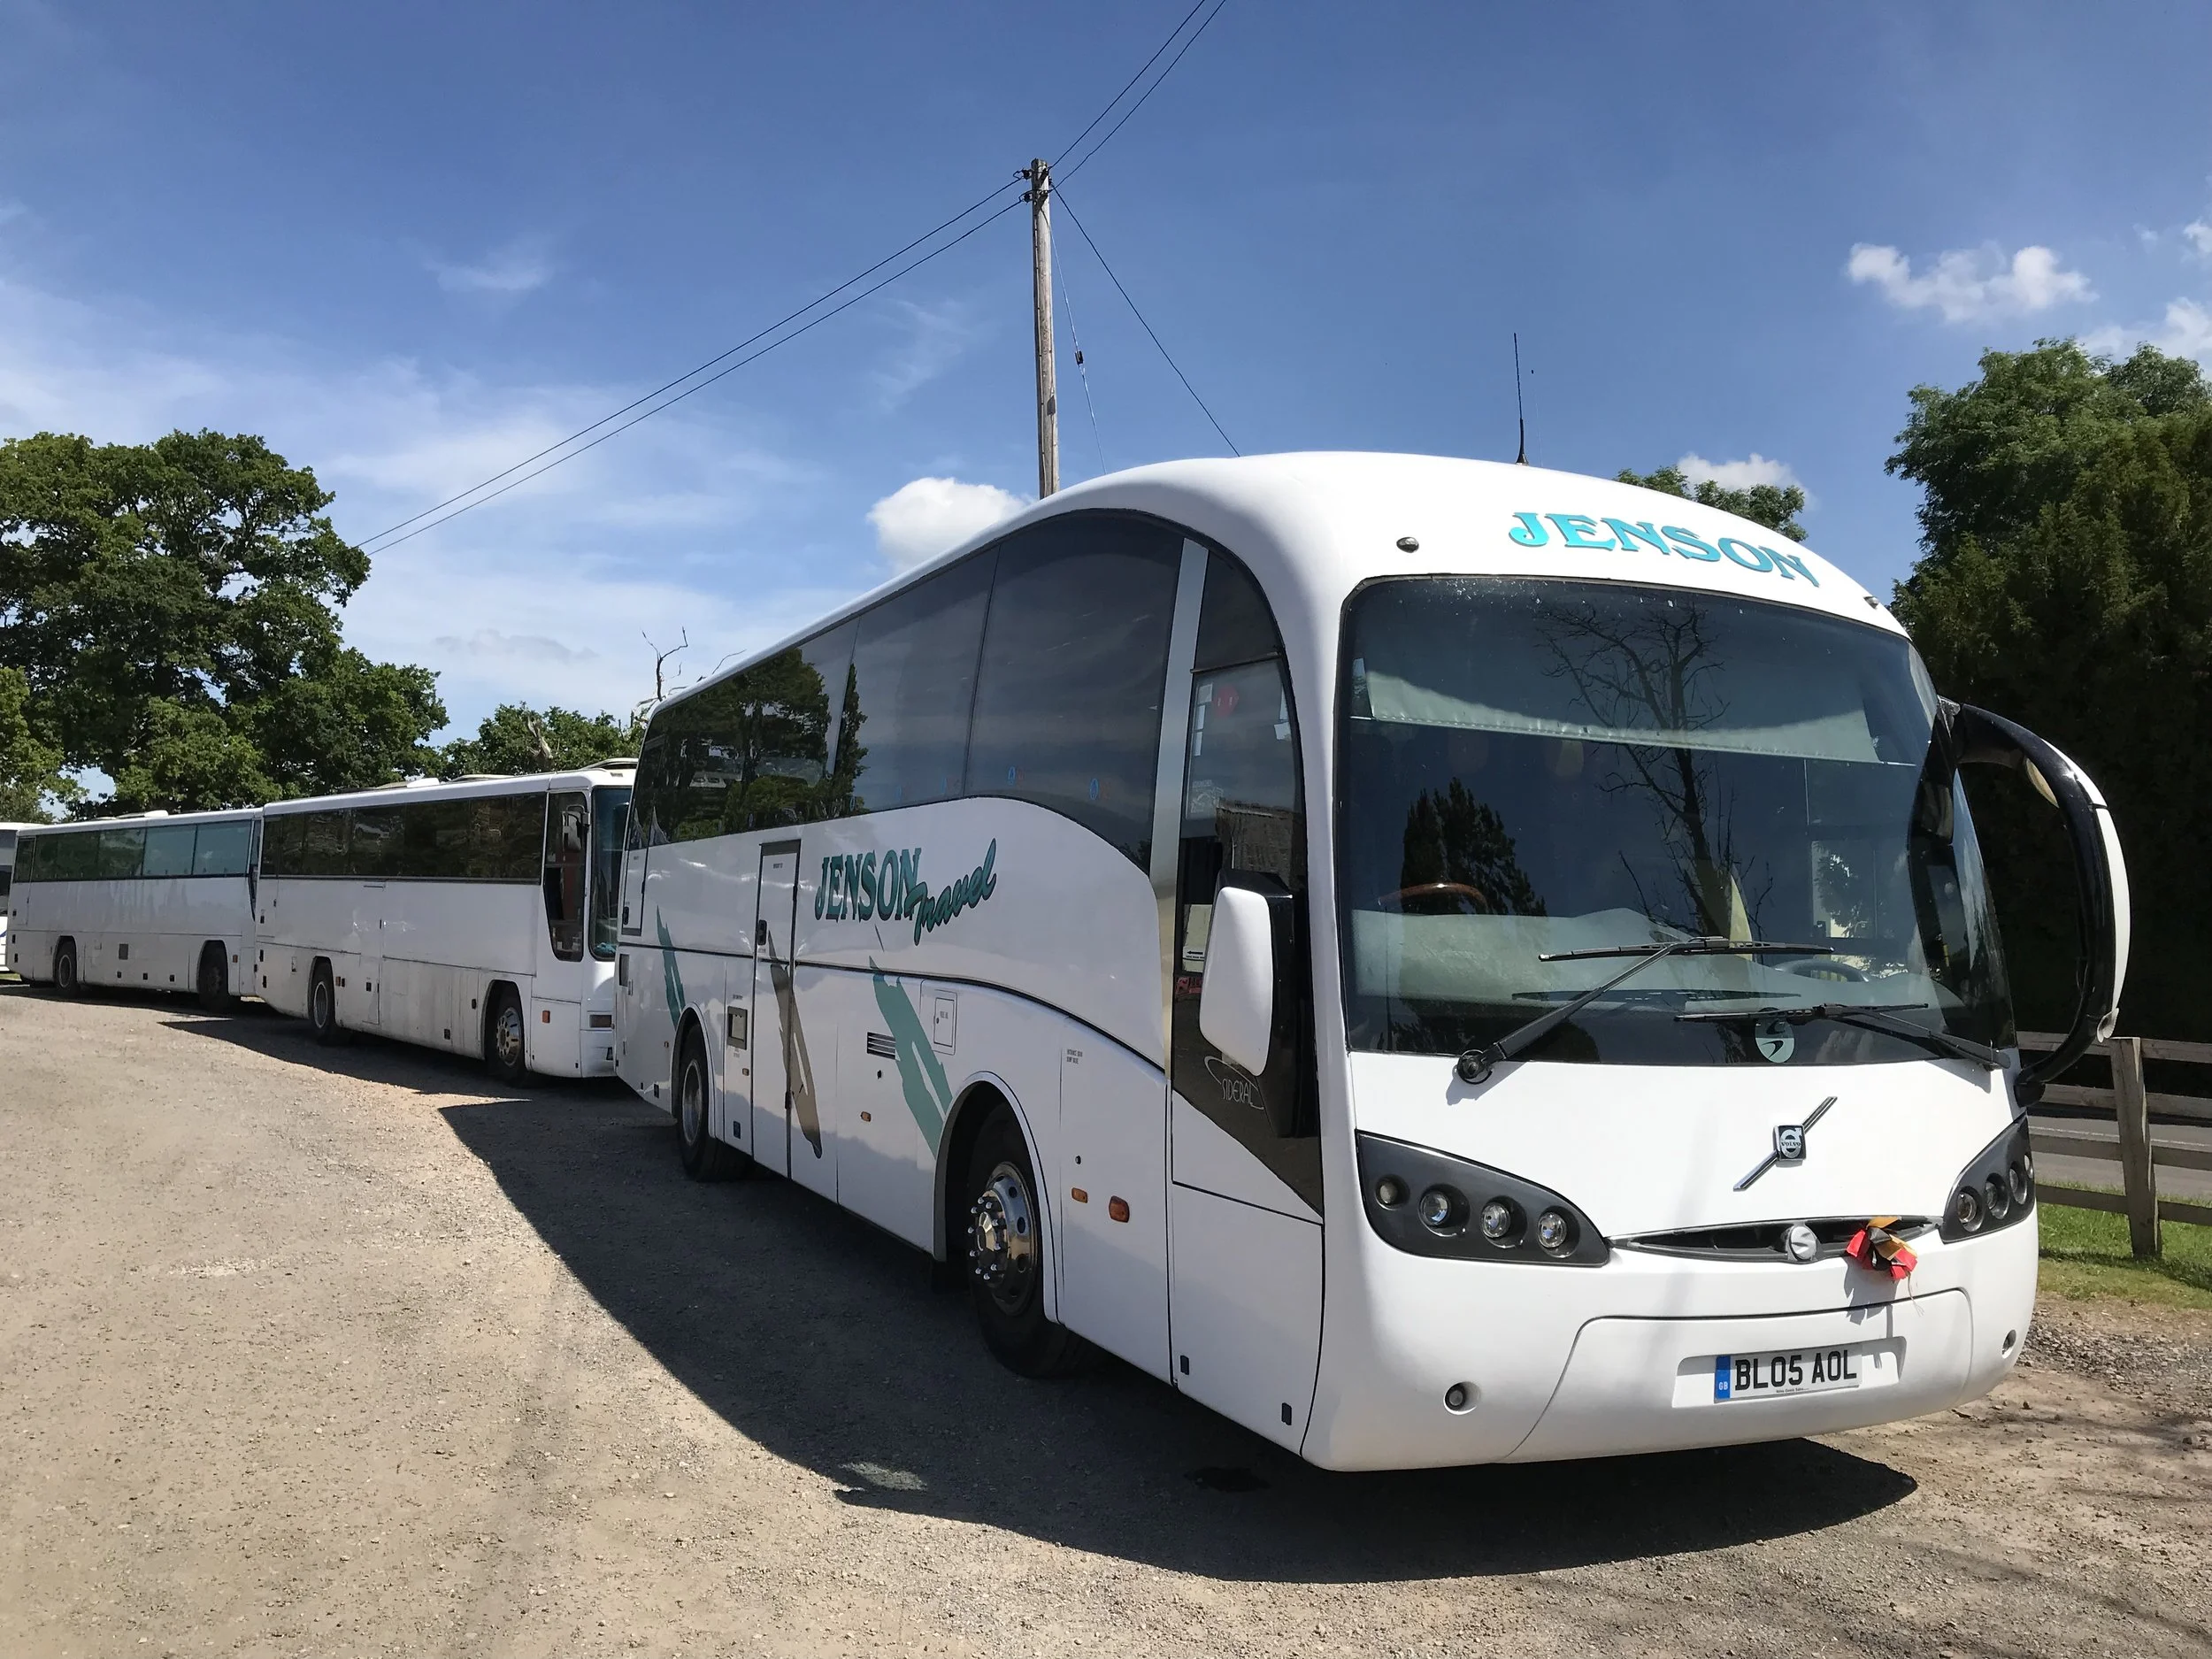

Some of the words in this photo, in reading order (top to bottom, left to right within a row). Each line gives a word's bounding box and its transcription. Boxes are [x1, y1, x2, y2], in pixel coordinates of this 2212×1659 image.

[1509, 511, 1820, 588] JENSON
[814, 847, 922, 923] JENSON
[903, 838, 997, 947] Travel
[1718, 1381, 1729, 1390] GB
[1811, 1349, 1857, 1384] AOL
